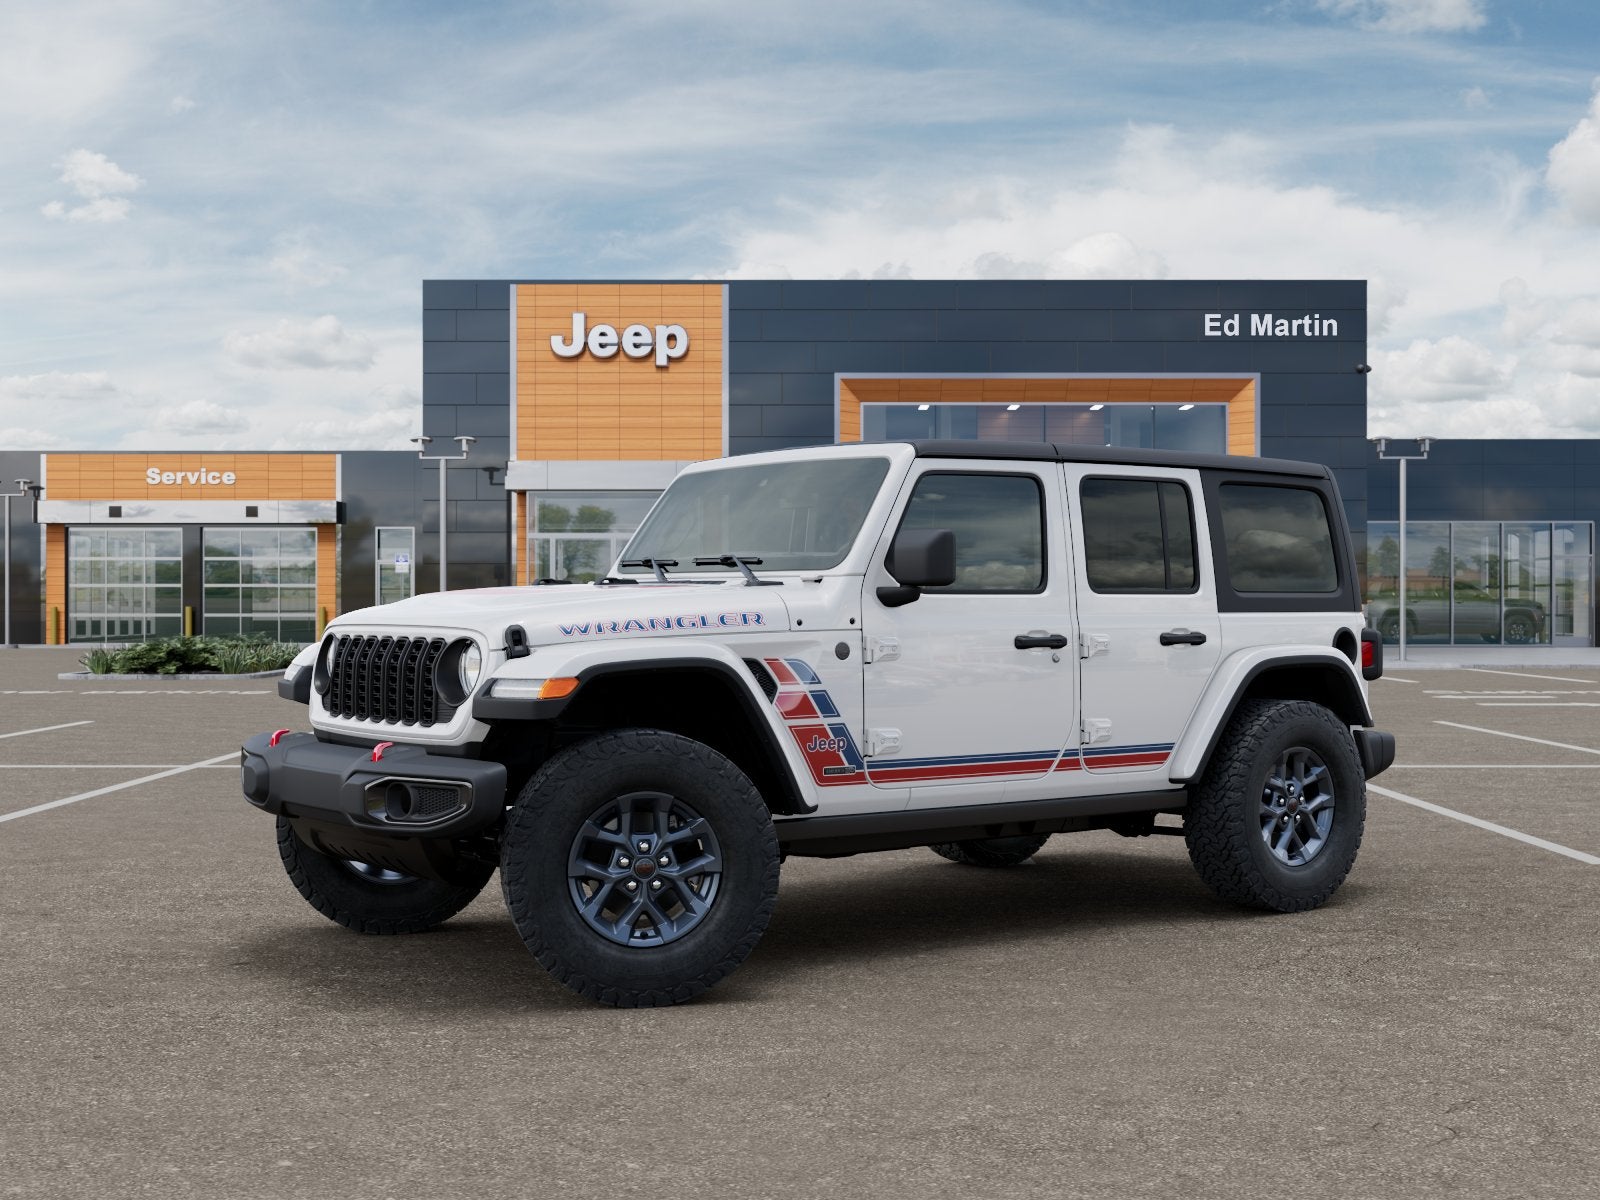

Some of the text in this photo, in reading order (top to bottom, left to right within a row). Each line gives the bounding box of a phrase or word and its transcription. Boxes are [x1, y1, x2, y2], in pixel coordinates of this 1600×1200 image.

[1204, 313, 1338, 336] Ed Martin
[550, 312, 690, 367] Jeep
[146, 467, 236, 485] Service
[559, 612, 765, 636] WRANGLER
[807, 735, 847, 754] Jeep
